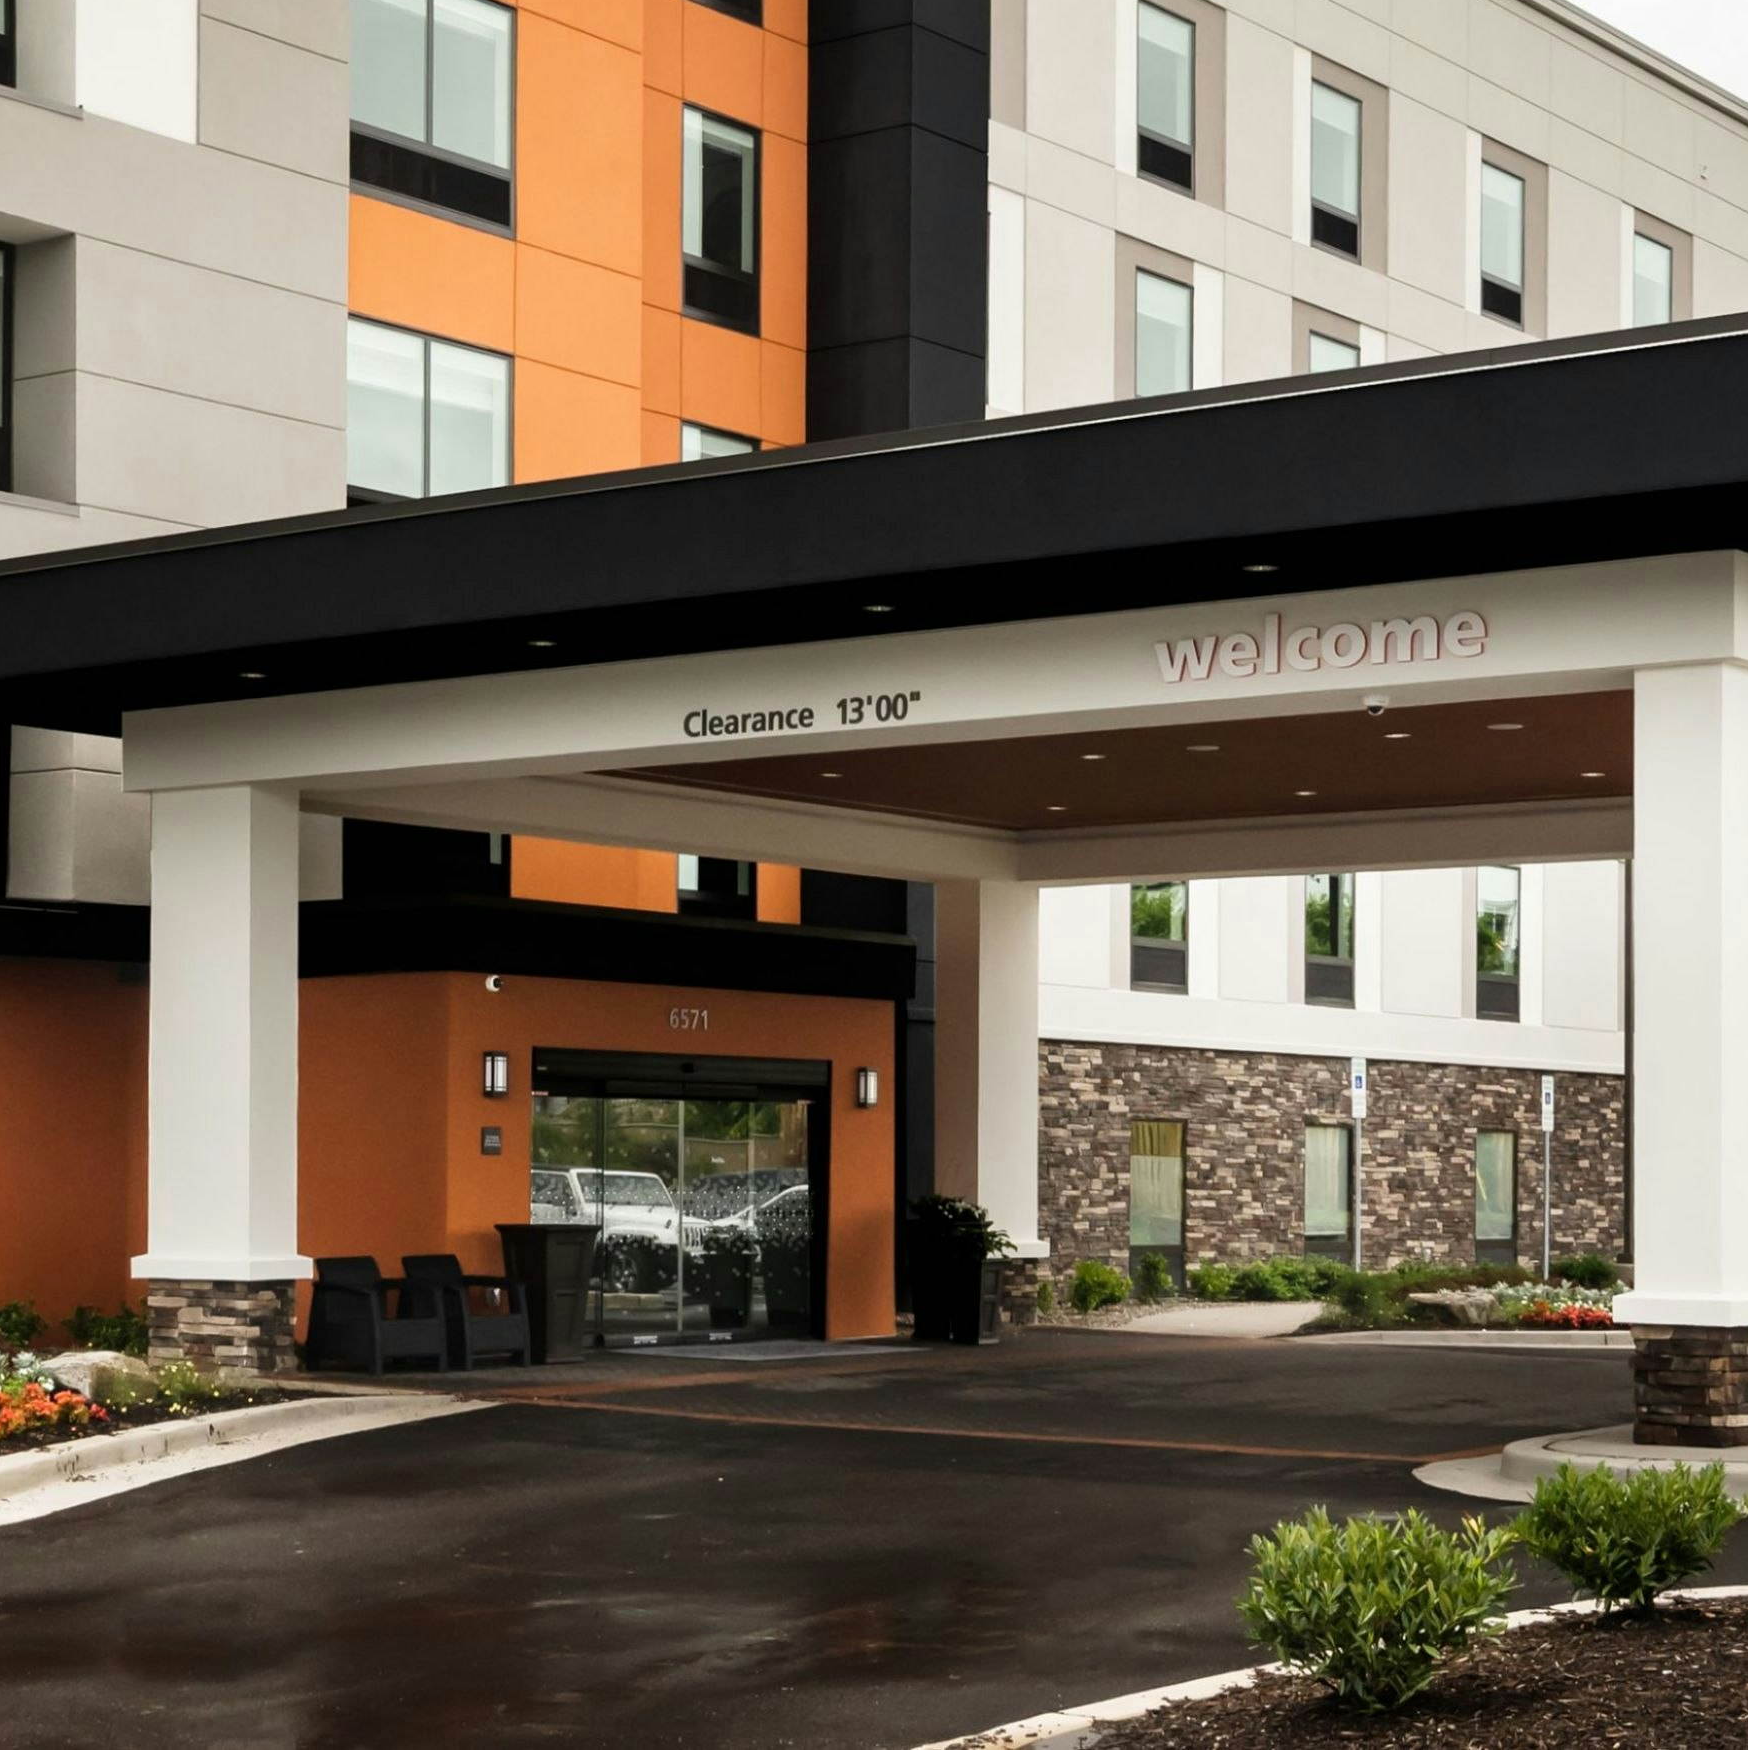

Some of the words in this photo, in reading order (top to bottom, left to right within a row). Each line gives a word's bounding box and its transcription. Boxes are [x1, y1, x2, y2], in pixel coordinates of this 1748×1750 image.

[1154, 609, 1488, 684] welcome
[683, 707, 815, 738] Clearance
[836, 690, 921, 725] 13'00"
[669, 1008, 708, 1030] 6571
